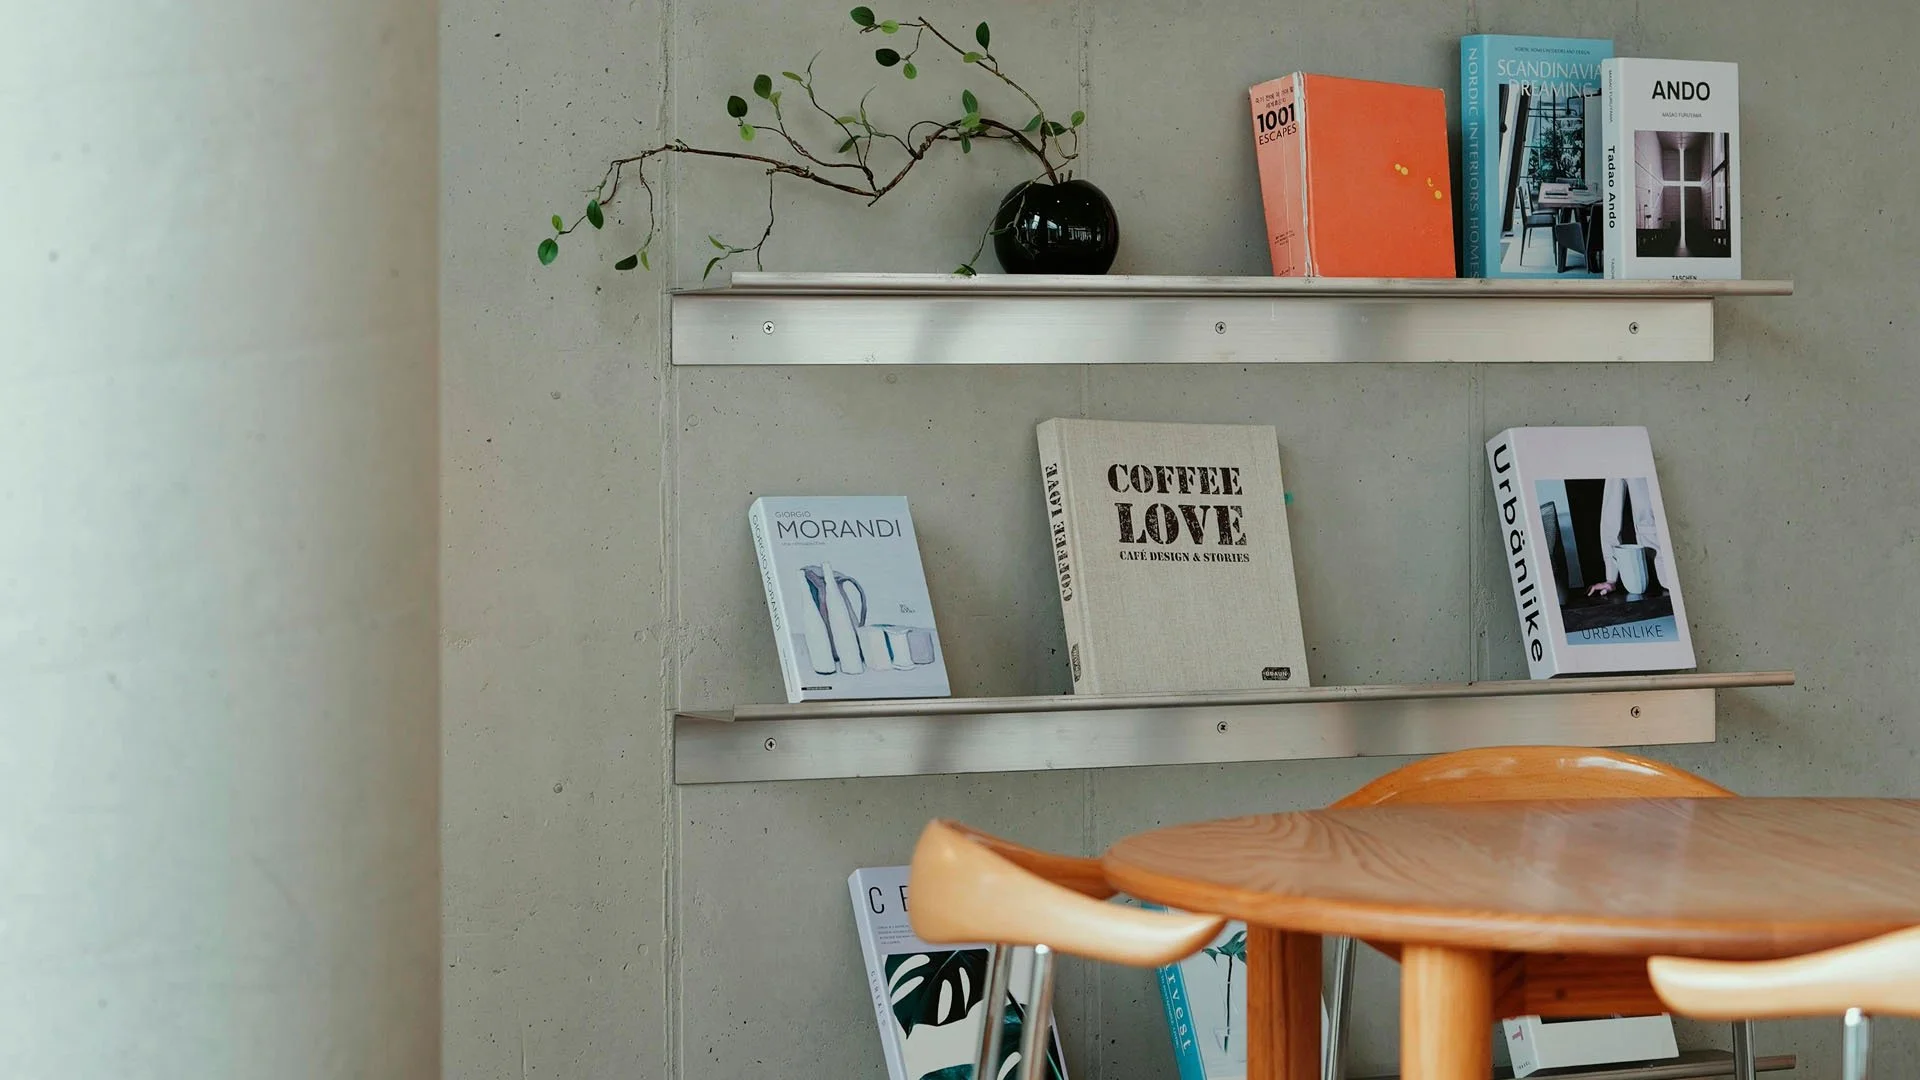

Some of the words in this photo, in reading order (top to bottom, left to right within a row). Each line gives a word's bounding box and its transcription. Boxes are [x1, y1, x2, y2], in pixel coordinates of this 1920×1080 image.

[1468, 48, 1479, 117] NORDIC
[1508, 79, 1593, 98] DREAMING
[1651, 80, 1711, 101] ANDO
[1257, 103, 1295, 133] 1001
[1259, 123, 1297, 145] ESCAPES
[1469, 121, 1480, 211] INTERIORS
[1608, 145, 1616, 188] Tadao
[1608, 192, 1617, 229] Ando
[1470, 217, 1480, 278] HOMES
[1045, 463, 1063, 519] LOVE
[1107, 463, 1243, 496] COFFEE
[776, 519, 902, 539] MORANDI
[1114, 502, 1248, 546] LOVE
[1053, 521, 1073, 602] COFFEE
[1120, 549, 1148, 561] CAFÉ
[1150, 551, 1190, 562] DESIGN
[1193, 552, 1201, 562] &
[1203, 553, 1250, 563] STORIES
[1493, 443, 1543, 662] Urbänlike
[752, 514, 768, 570] GIORGIO
[765, 571, 781, 632] MORANDI
[1582, 624, 1664, 640] URBANLIKE
